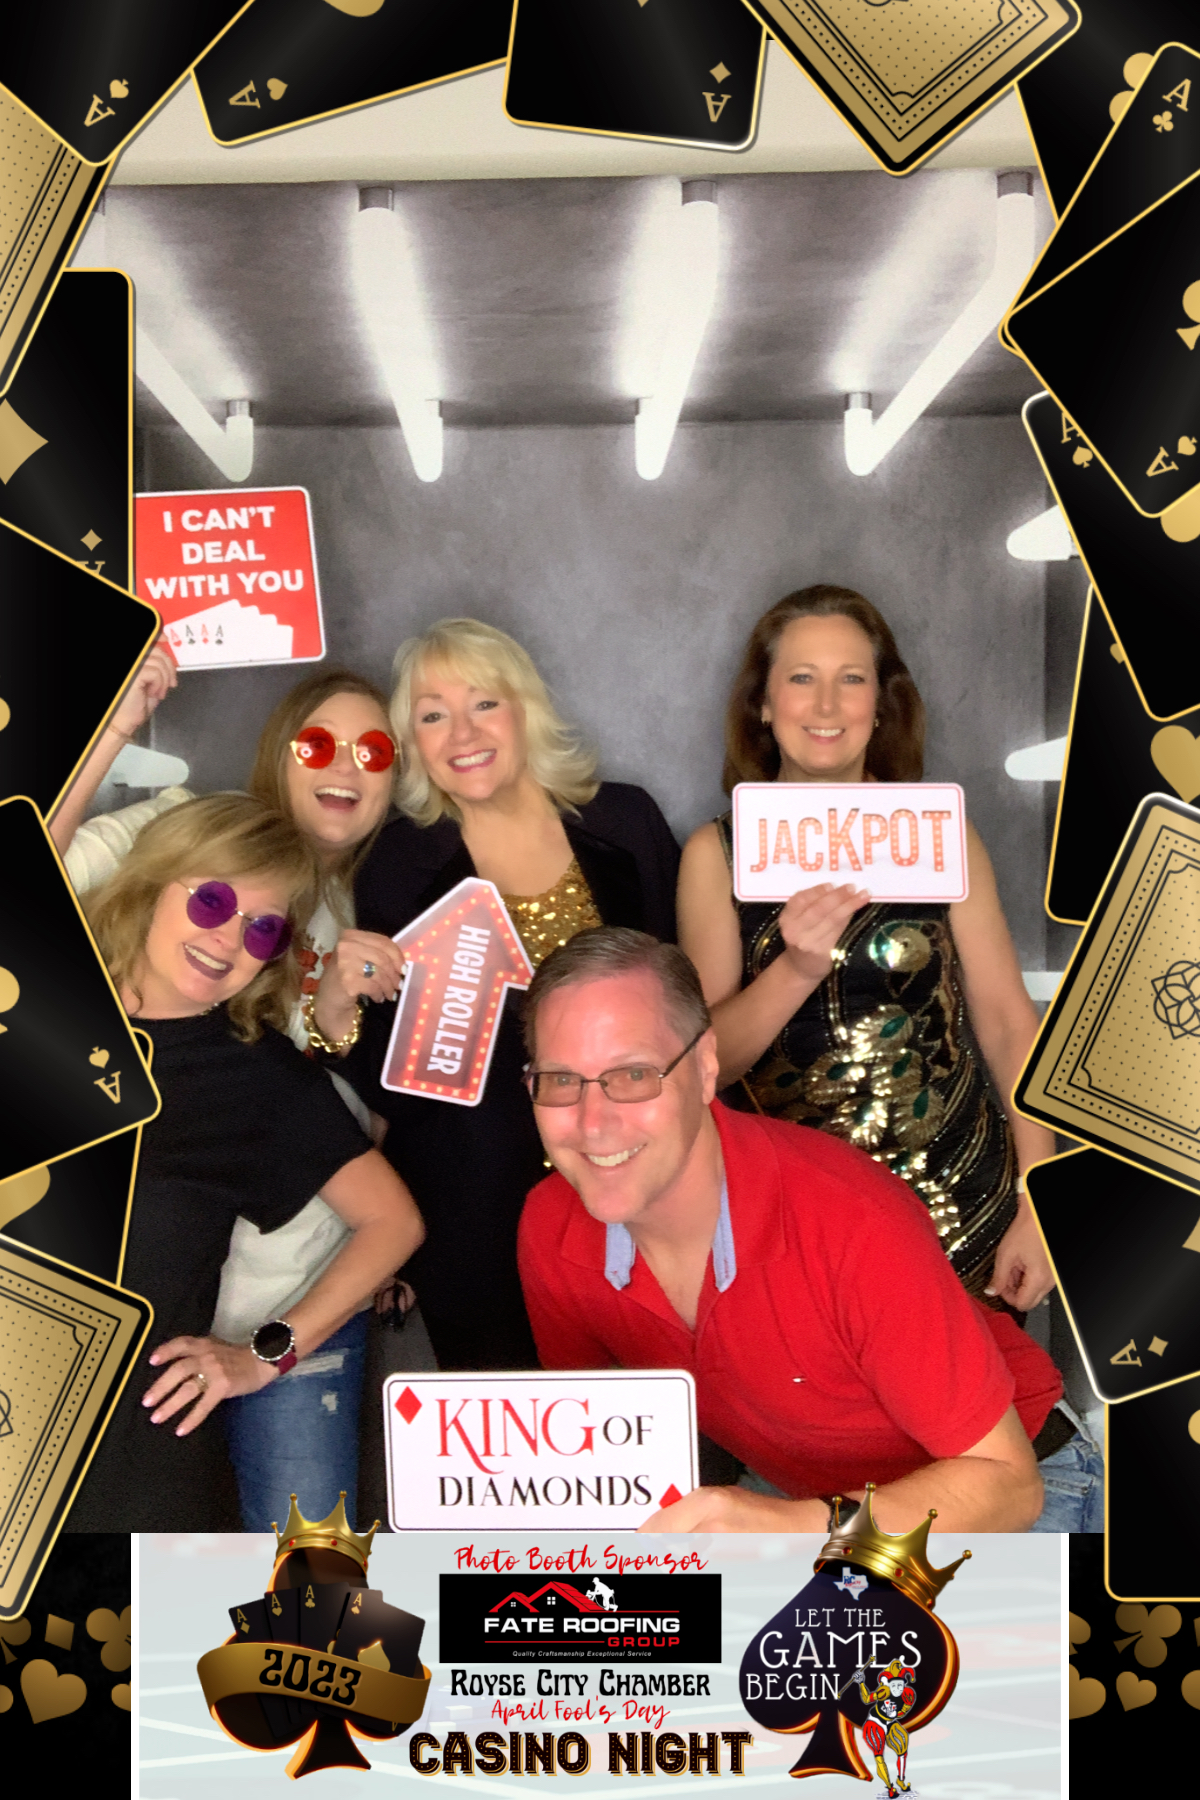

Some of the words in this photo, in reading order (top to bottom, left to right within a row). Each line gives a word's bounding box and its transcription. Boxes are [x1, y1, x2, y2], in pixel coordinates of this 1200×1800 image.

[163, 511, 173, 533] I
[181, 505, 275, 532] CAN'T
[181, 539, 266, 565] DEAL
[145, 573, 230, 600] WITH
[236, 569, 304, 594] YOU
[750, 808, 952, 872] JACKPOT
[448, 924, 491, 985] HIGH
[426, 988, 478, 1075] ROLLER
[435, 1398, 597, 1475] KING
[602, 1415, 654, 1446] OF
[438, 1475, 652, 1507] DIAMONDS
